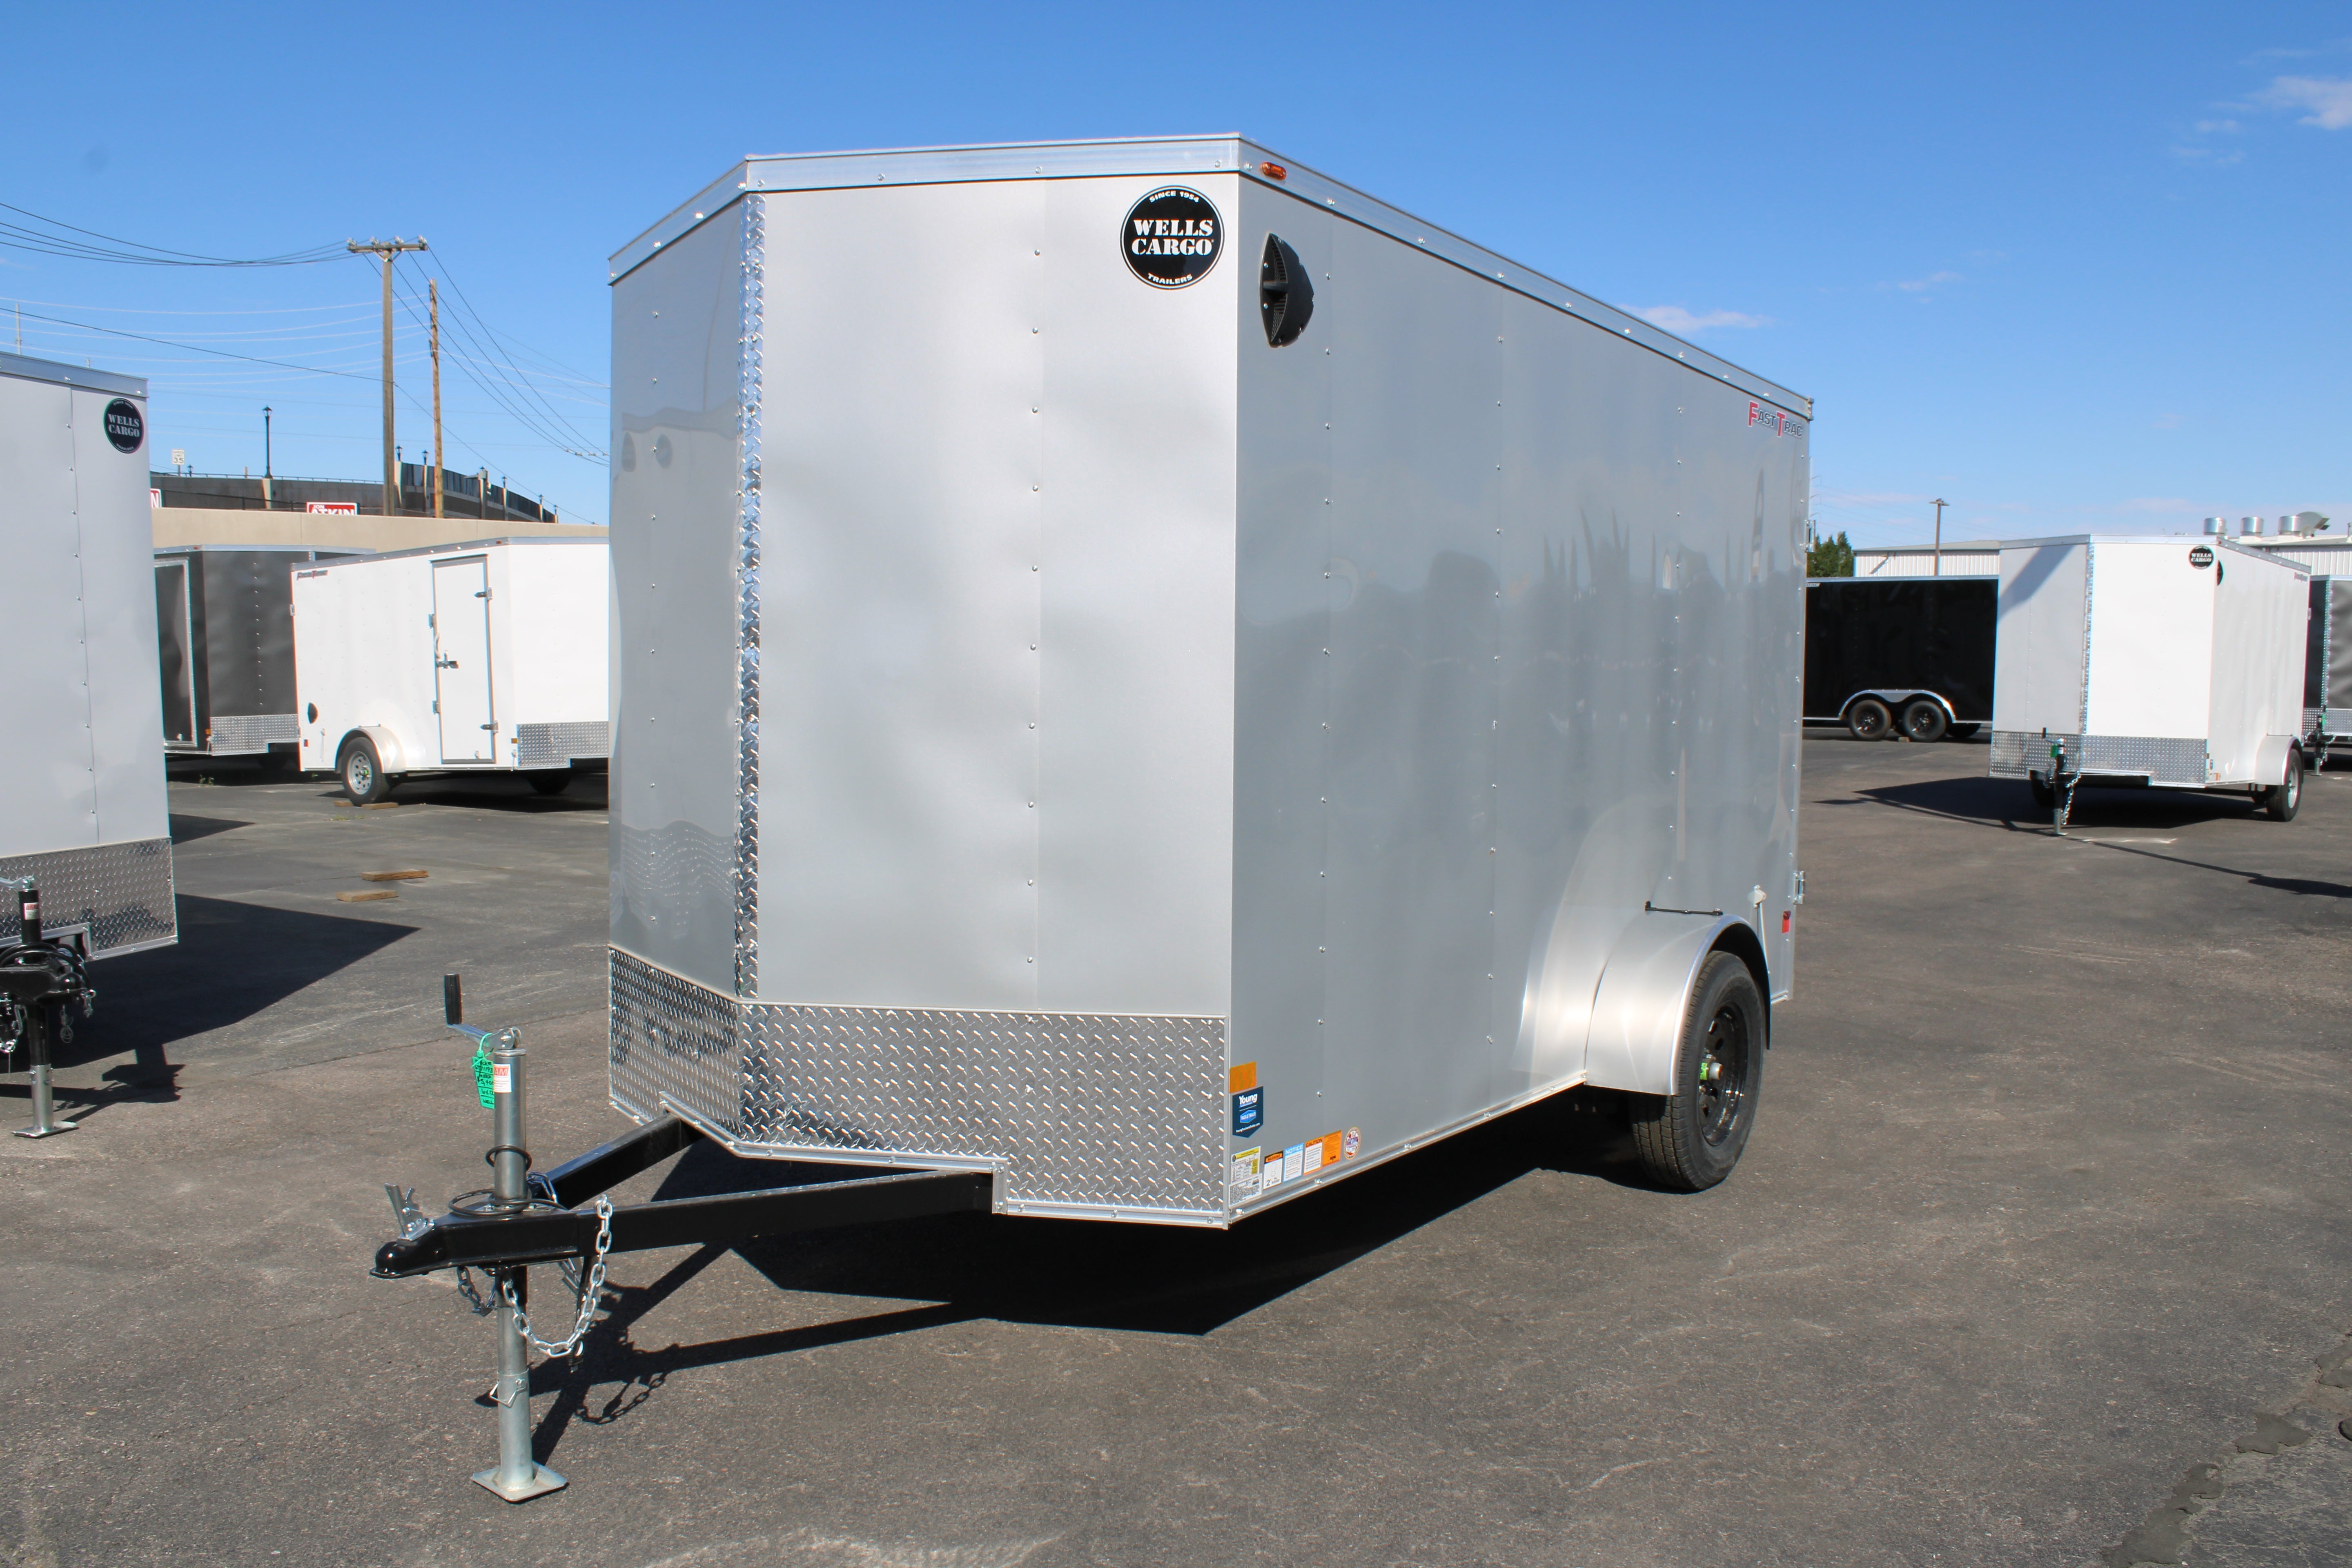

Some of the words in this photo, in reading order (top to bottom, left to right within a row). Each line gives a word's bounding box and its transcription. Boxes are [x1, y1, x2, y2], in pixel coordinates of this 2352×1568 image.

[1149, 191, 1176, 203] SINCE
[1180, 191, 1199, 203] 1954
[1133, 219, 1213, 236] WELLS
[1131, 238, 1212, 255] CARGO
[1148, 273, 1193, 285] TRAILERS
[107, 413, 140, 427] WELLS
[108, 424, 140, 437] CARGO
[1239, 1094, 1258, 1105] Young
[1306, 1138, 1323, 1147] CAUTION
[1285, 1145, 1303, 1154] NOTICE
